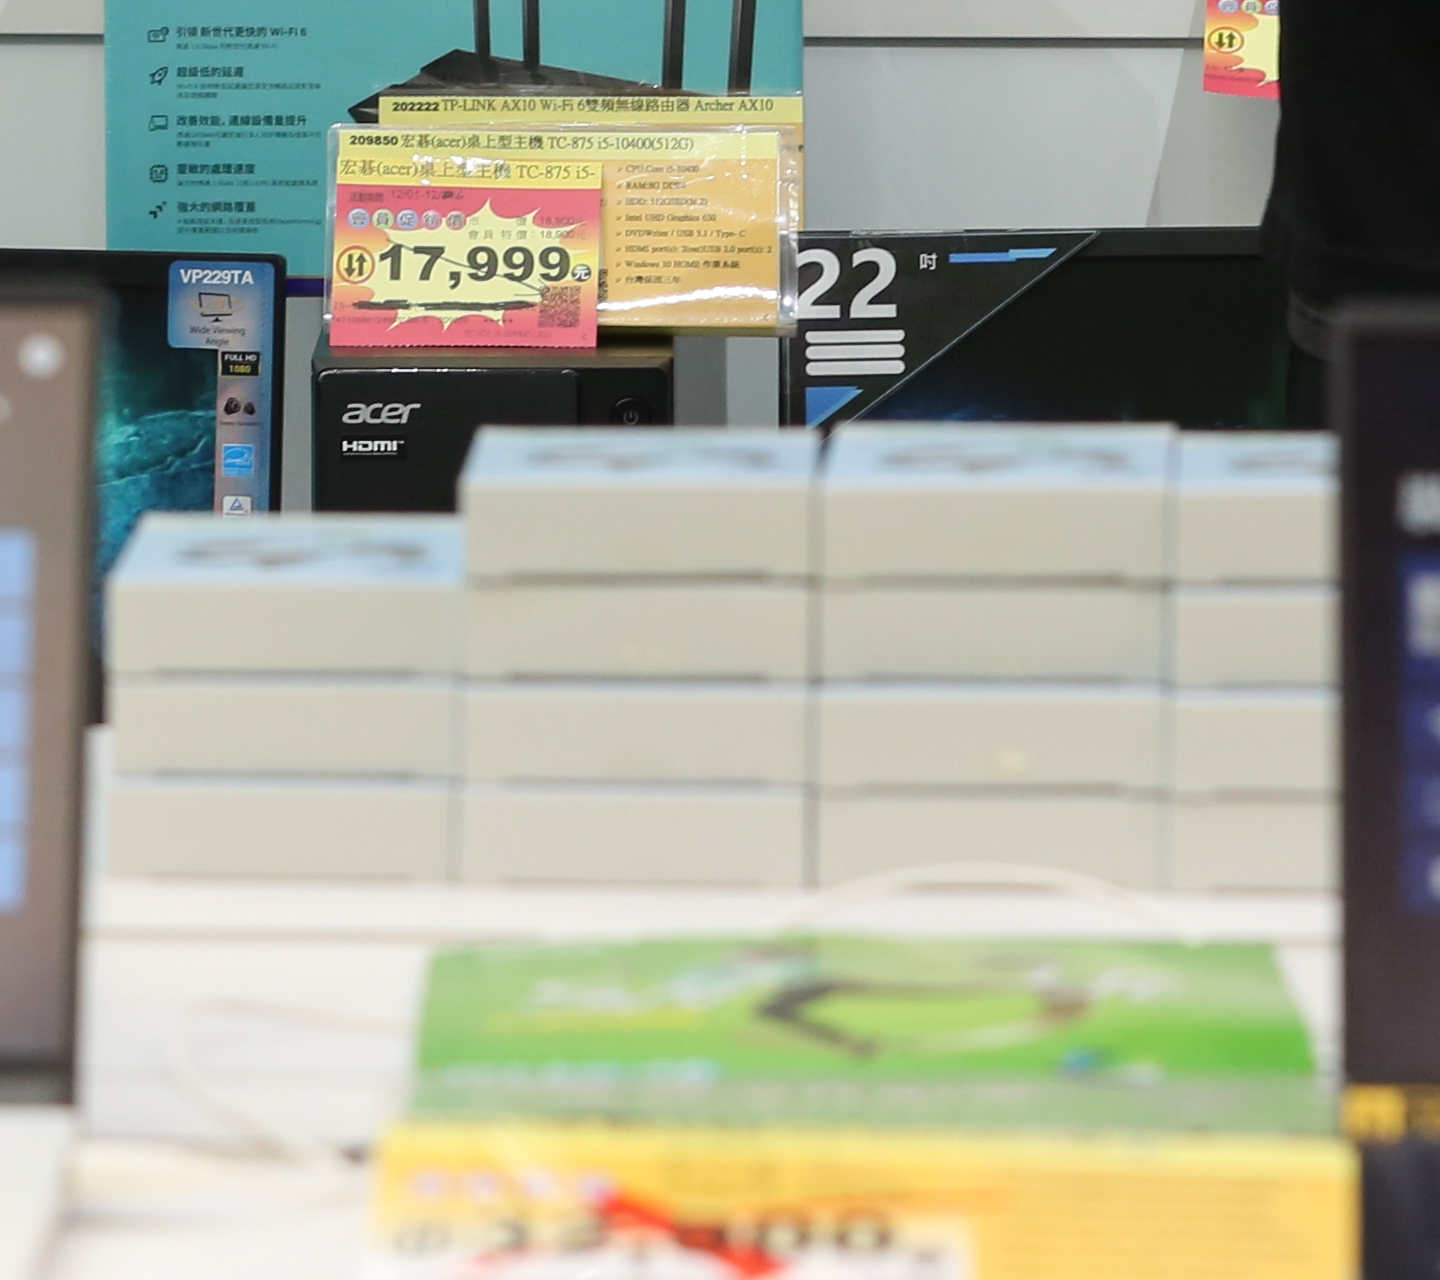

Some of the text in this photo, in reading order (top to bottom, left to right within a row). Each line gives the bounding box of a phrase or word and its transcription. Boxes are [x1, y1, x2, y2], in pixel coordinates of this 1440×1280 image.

[270, 26, 298, 37] Wi-Fi
[391, 101, 440, 113] 202222
[440, 98, 496, 114] TP-LINK
[500, 98, 537, 114] AX10
[540, 98, 574, 113] Wi-Fi
[694, 98, 734, 114] Archer
[737, 99, 774, 114] AX10
[348, 133, 695, 153] 209850 宏碁(acer)桌上型主機 TC-875 i5-10400(512G)
[516, 162, 571, 181] TC-875
[378, 243, 592, 290] 17,999 元
[179, 268, 255, 285] VP229TA
[795, 247, 898, 320] 22
[224, 353, 244, 362] FULL
[341, 402, 422, 425] acer
[341, 440, 400, 453] HDMI
